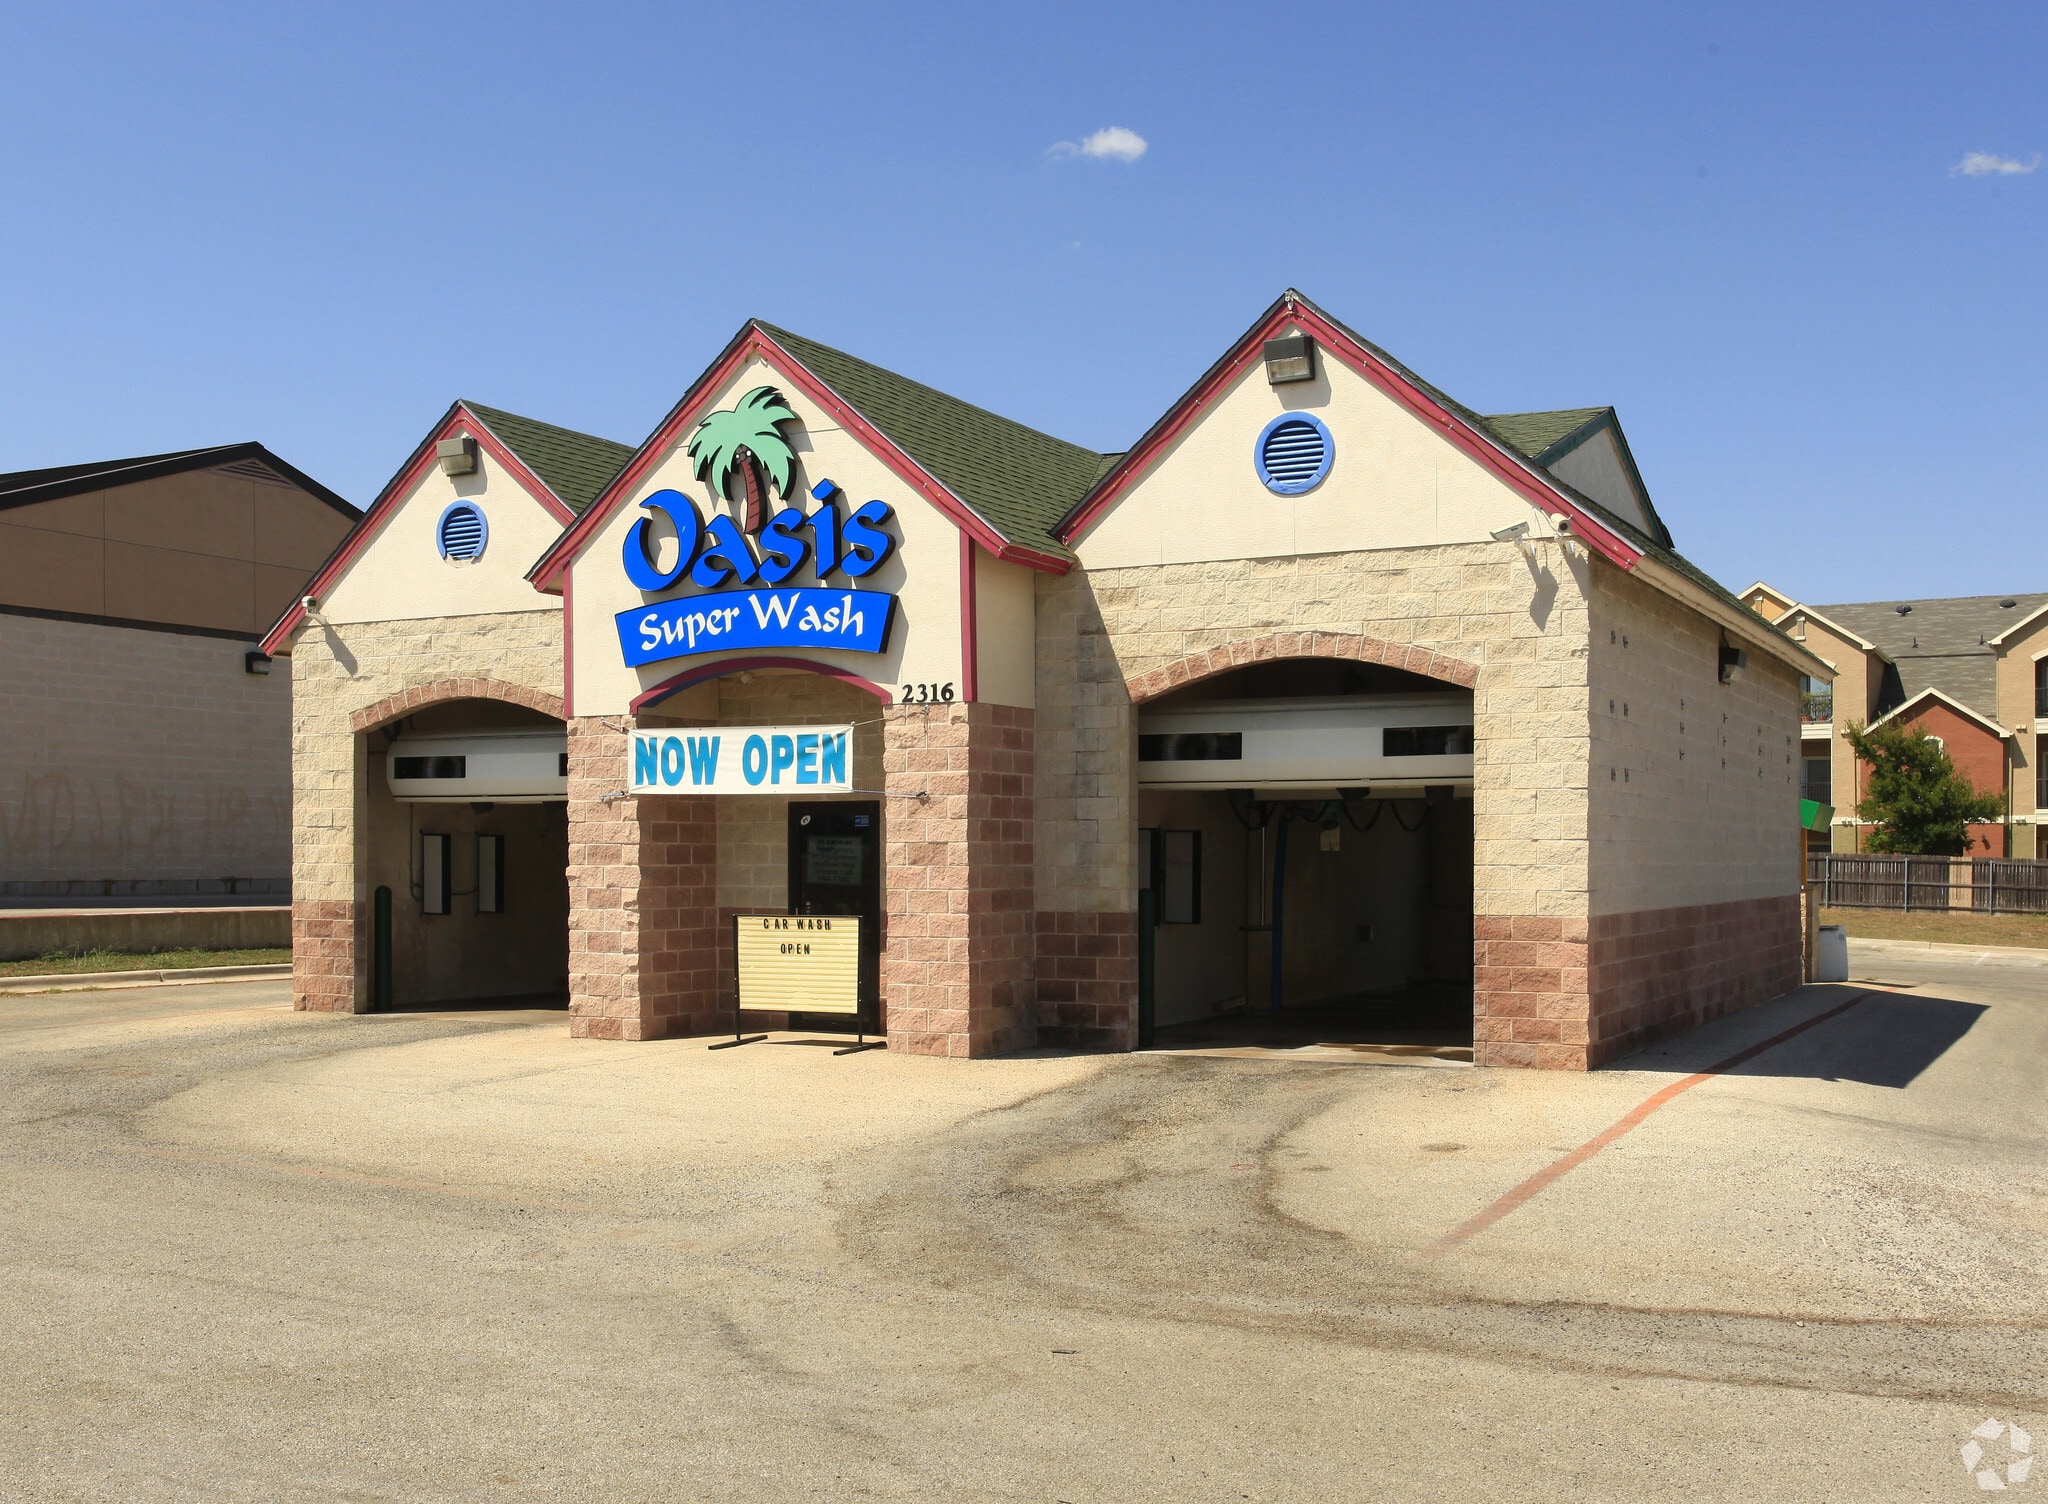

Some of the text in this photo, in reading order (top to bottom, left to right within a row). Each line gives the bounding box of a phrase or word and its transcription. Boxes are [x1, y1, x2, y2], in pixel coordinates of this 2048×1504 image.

[622, 479, 894, 592] Oasis
[639, 592, 864, 651] Super Wash
[902, 682, 954, 702] 2316
[635, 733, 846, 787] NOW OPEN
[763, 918, 831, 930] CAR WASH
[780, 943, 810, 954] OPEN
